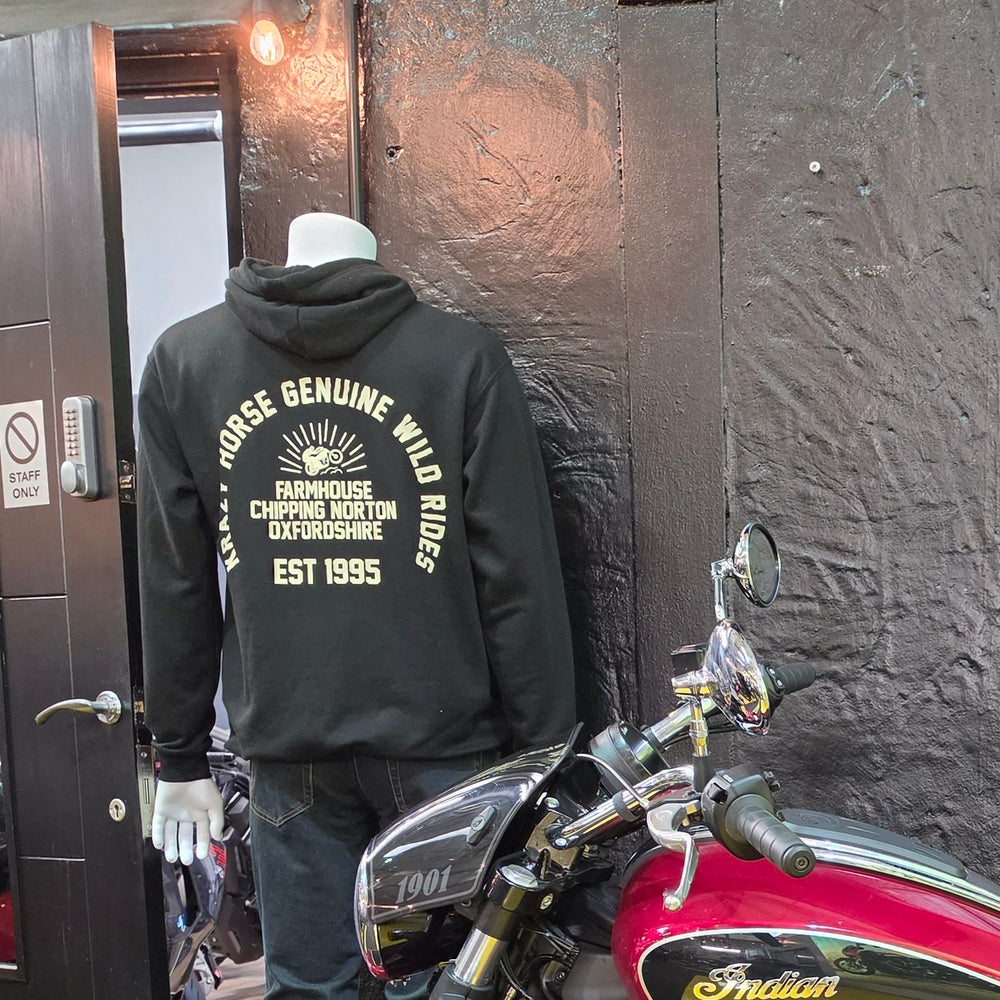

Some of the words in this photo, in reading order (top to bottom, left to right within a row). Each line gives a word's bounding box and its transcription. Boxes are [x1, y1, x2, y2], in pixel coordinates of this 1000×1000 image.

[280, 376, 395, 423] GENUINE
[219, 389, 278, 470] HORSE
[392, 413, 443, 485] WILD
[9, 469, 41, 484] STAFF
[12, 486, 40, 499] ONLY
[275, 480, 373, 500] FARMHOUSE
[250, 500, 326, 520] CHIPPING
[330, 500, 398, 520] NORTON
[268, 521, 384, 540] OXFORDSHIRE
[415, 494, 447, 574] RIDES
[273, 558, 317, 585] EST
[324, 558, 381, 585] 1995
[395, 865, 453, 904] 1901
[693, 963, 840, 1000] Indian
